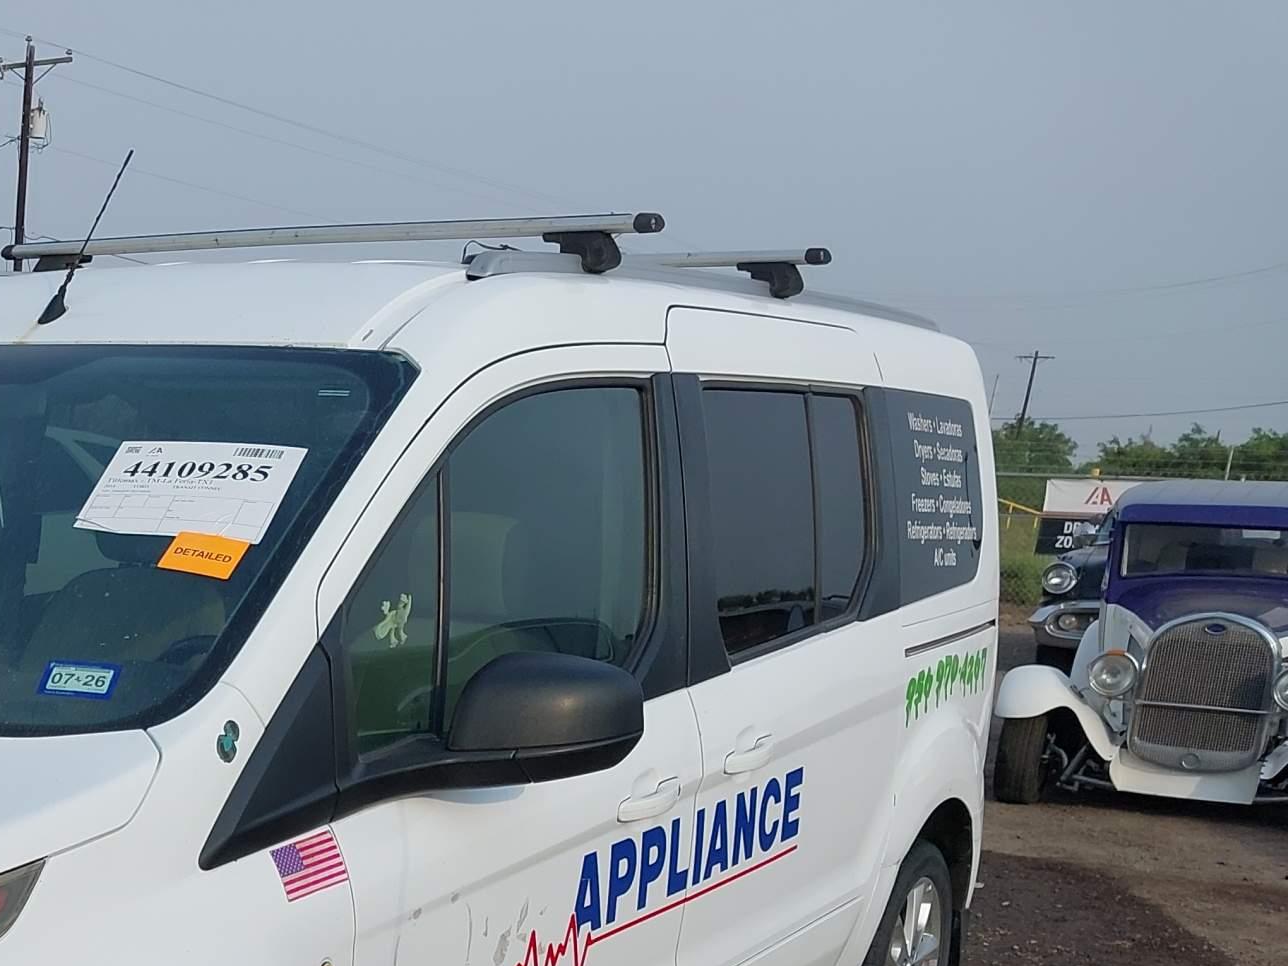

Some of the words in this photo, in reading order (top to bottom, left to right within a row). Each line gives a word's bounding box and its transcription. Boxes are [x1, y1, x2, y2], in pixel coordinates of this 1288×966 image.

[907, 412, 933, 433] Washers
[935, 416, 962, 437] Lavadoras
[913, 440, 933, 463] Dryers
[936, 441, 963, 463] Secadoras
[123, 461, 272, 481] 44109285
[920, 466, 940, 486] Stoves
[942, 469, 962, 488] Estufas
[911, 493, 936, 513] Freezers
[907, 520, 943, 544] Refrigerators
[174, 546, 232, 563] DETAILED
[573, 767, 804, 932] APPLIANCE
